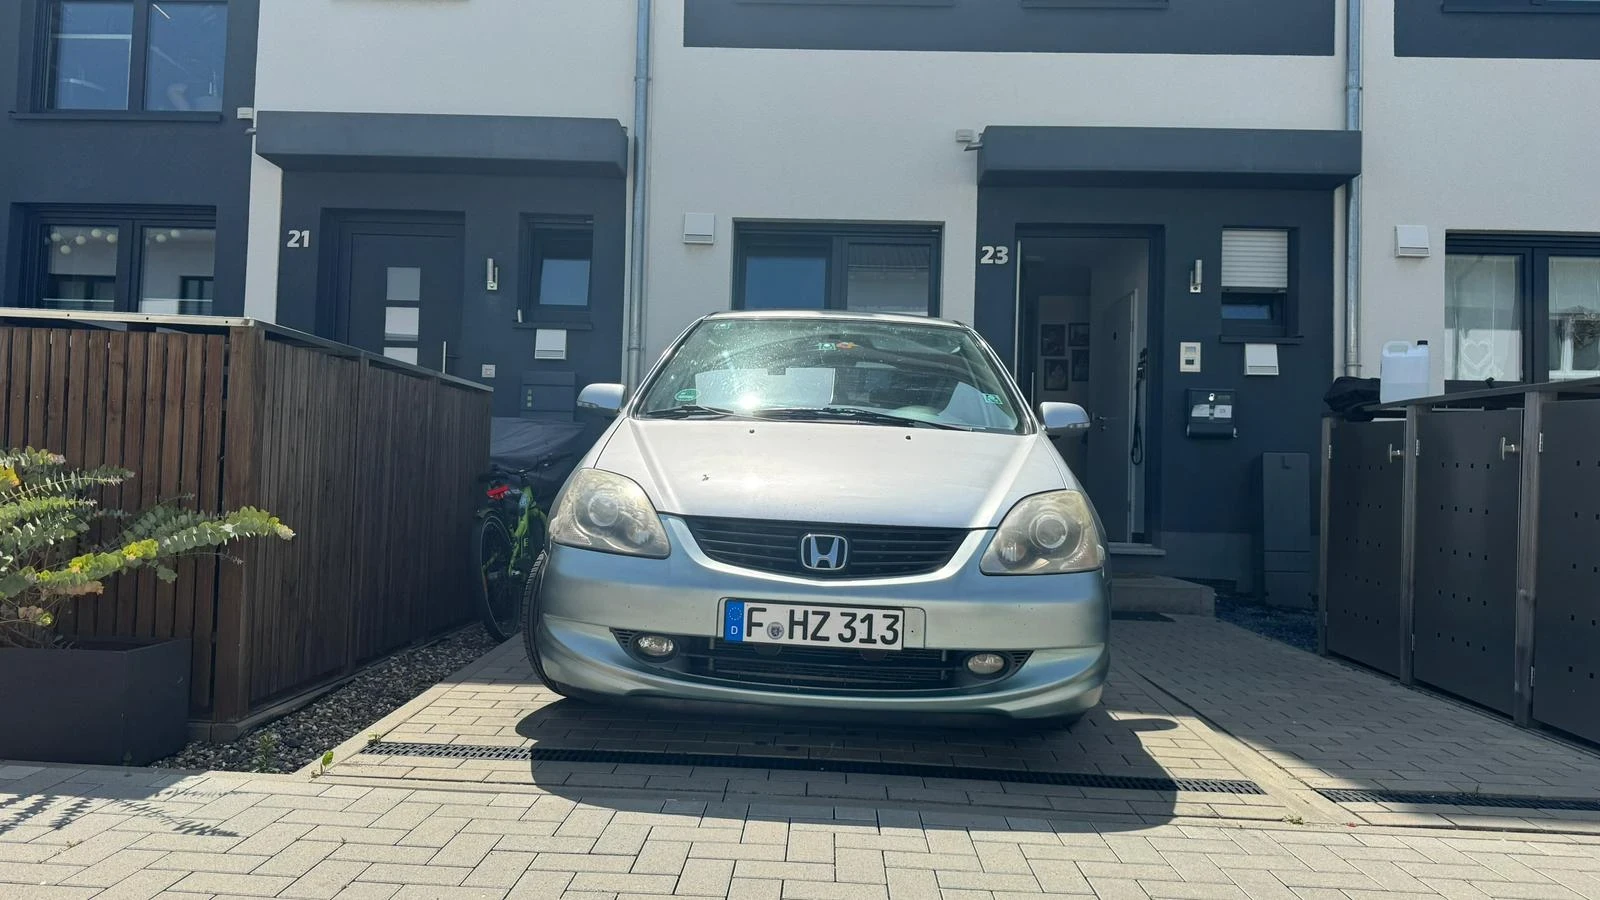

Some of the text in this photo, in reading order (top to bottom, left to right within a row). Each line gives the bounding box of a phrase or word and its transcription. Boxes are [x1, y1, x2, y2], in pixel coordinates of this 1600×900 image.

[287, 230, 310, 248] 21
[980, 245, 1009, 265] 23
[730, 625, 739, 635] D
[746, 607, 900, 646] F HZ 313
